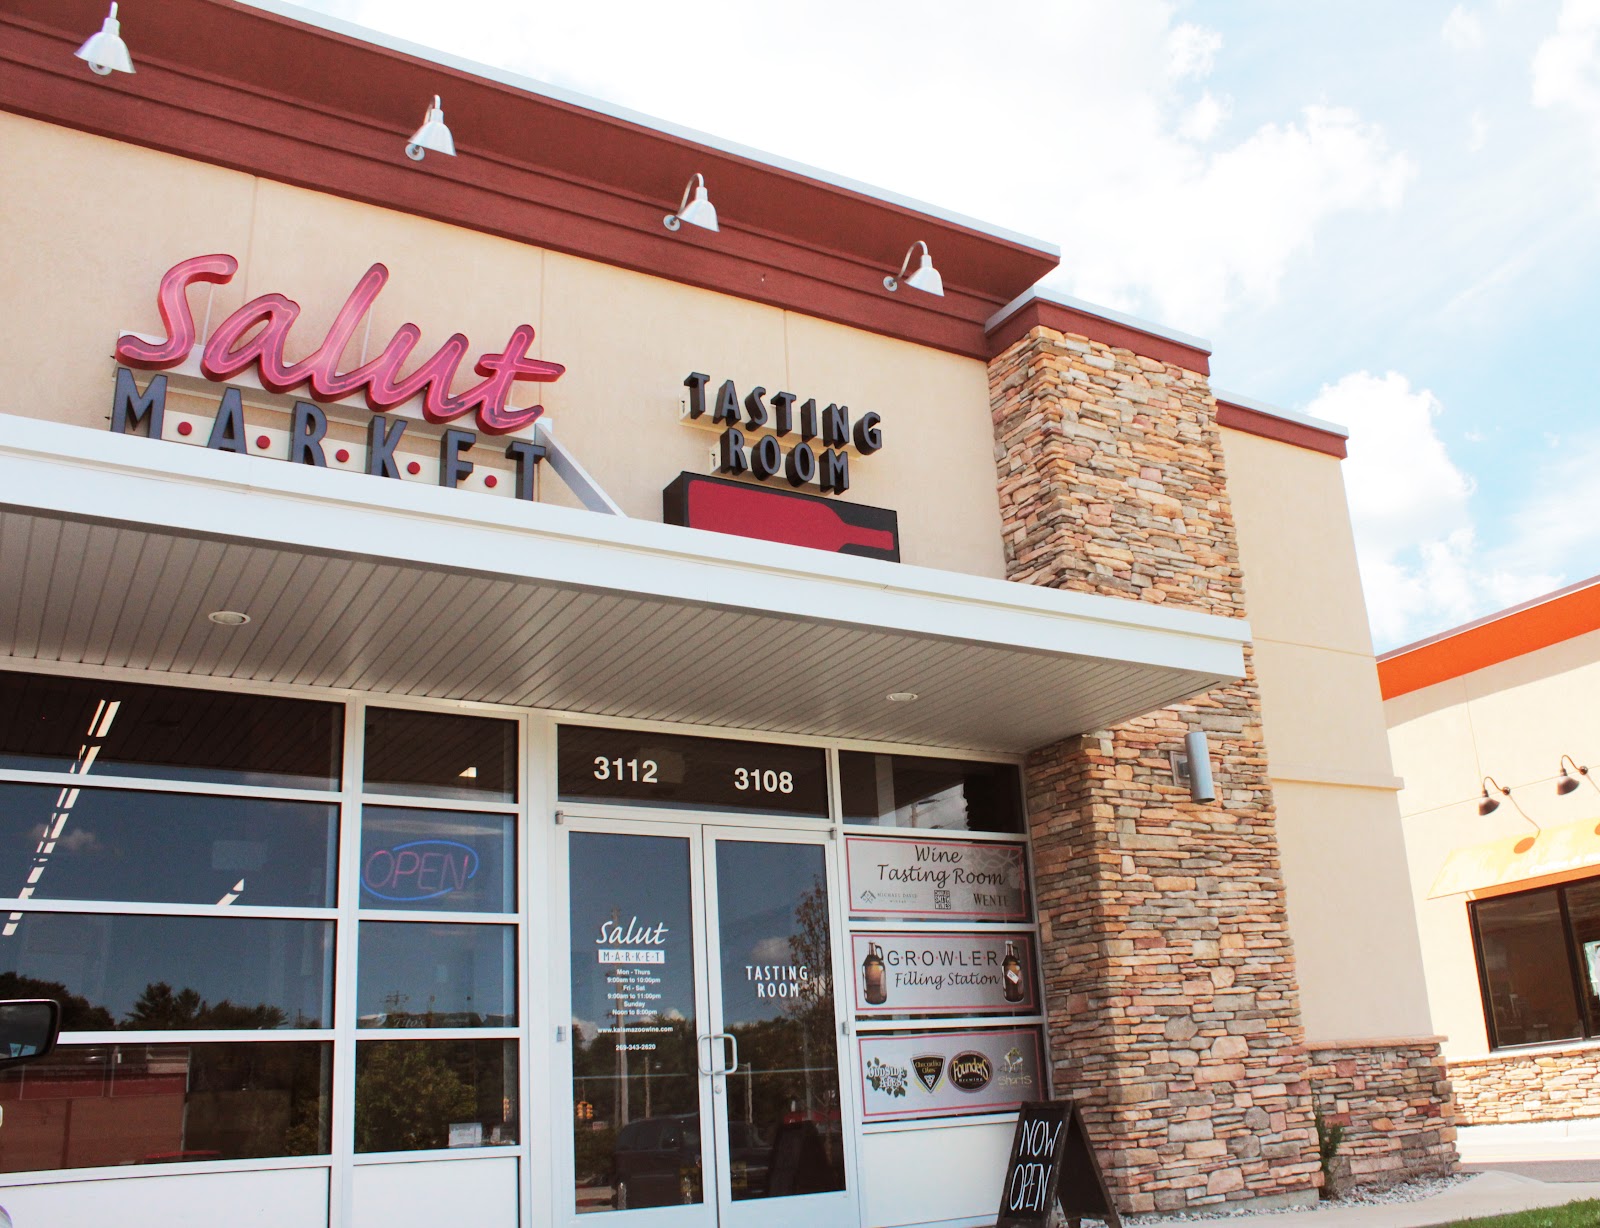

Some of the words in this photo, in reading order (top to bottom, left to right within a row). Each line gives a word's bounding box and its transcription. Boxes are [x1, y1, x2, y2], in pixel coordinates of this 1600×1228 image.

[113, 253, 566, 436] Salut
[683, 371, 883, 456] TASTING
[719, 427, 850, 496] ROOM
[593, 756, 659, 784] 3112
[734, 767, 794, 794] 3108
[914, 844, 963, 863] Wine
[365, 850, 469, 890] OPEN
[877, 864, 951, 889] Tasting
[953, 867, 1006, 886] Room
[595, 915, 669, 945] Salut
[745, 965, 808, 981] TASTING
[895, 971, 946, 991] Filling
[947, 972, 1001, 986] Station
[757, 982, 800, 998] ROOM
[1018, 1118, 1063, 1158] NOW
[1009, 1162, 1053, 1212] OPEN
